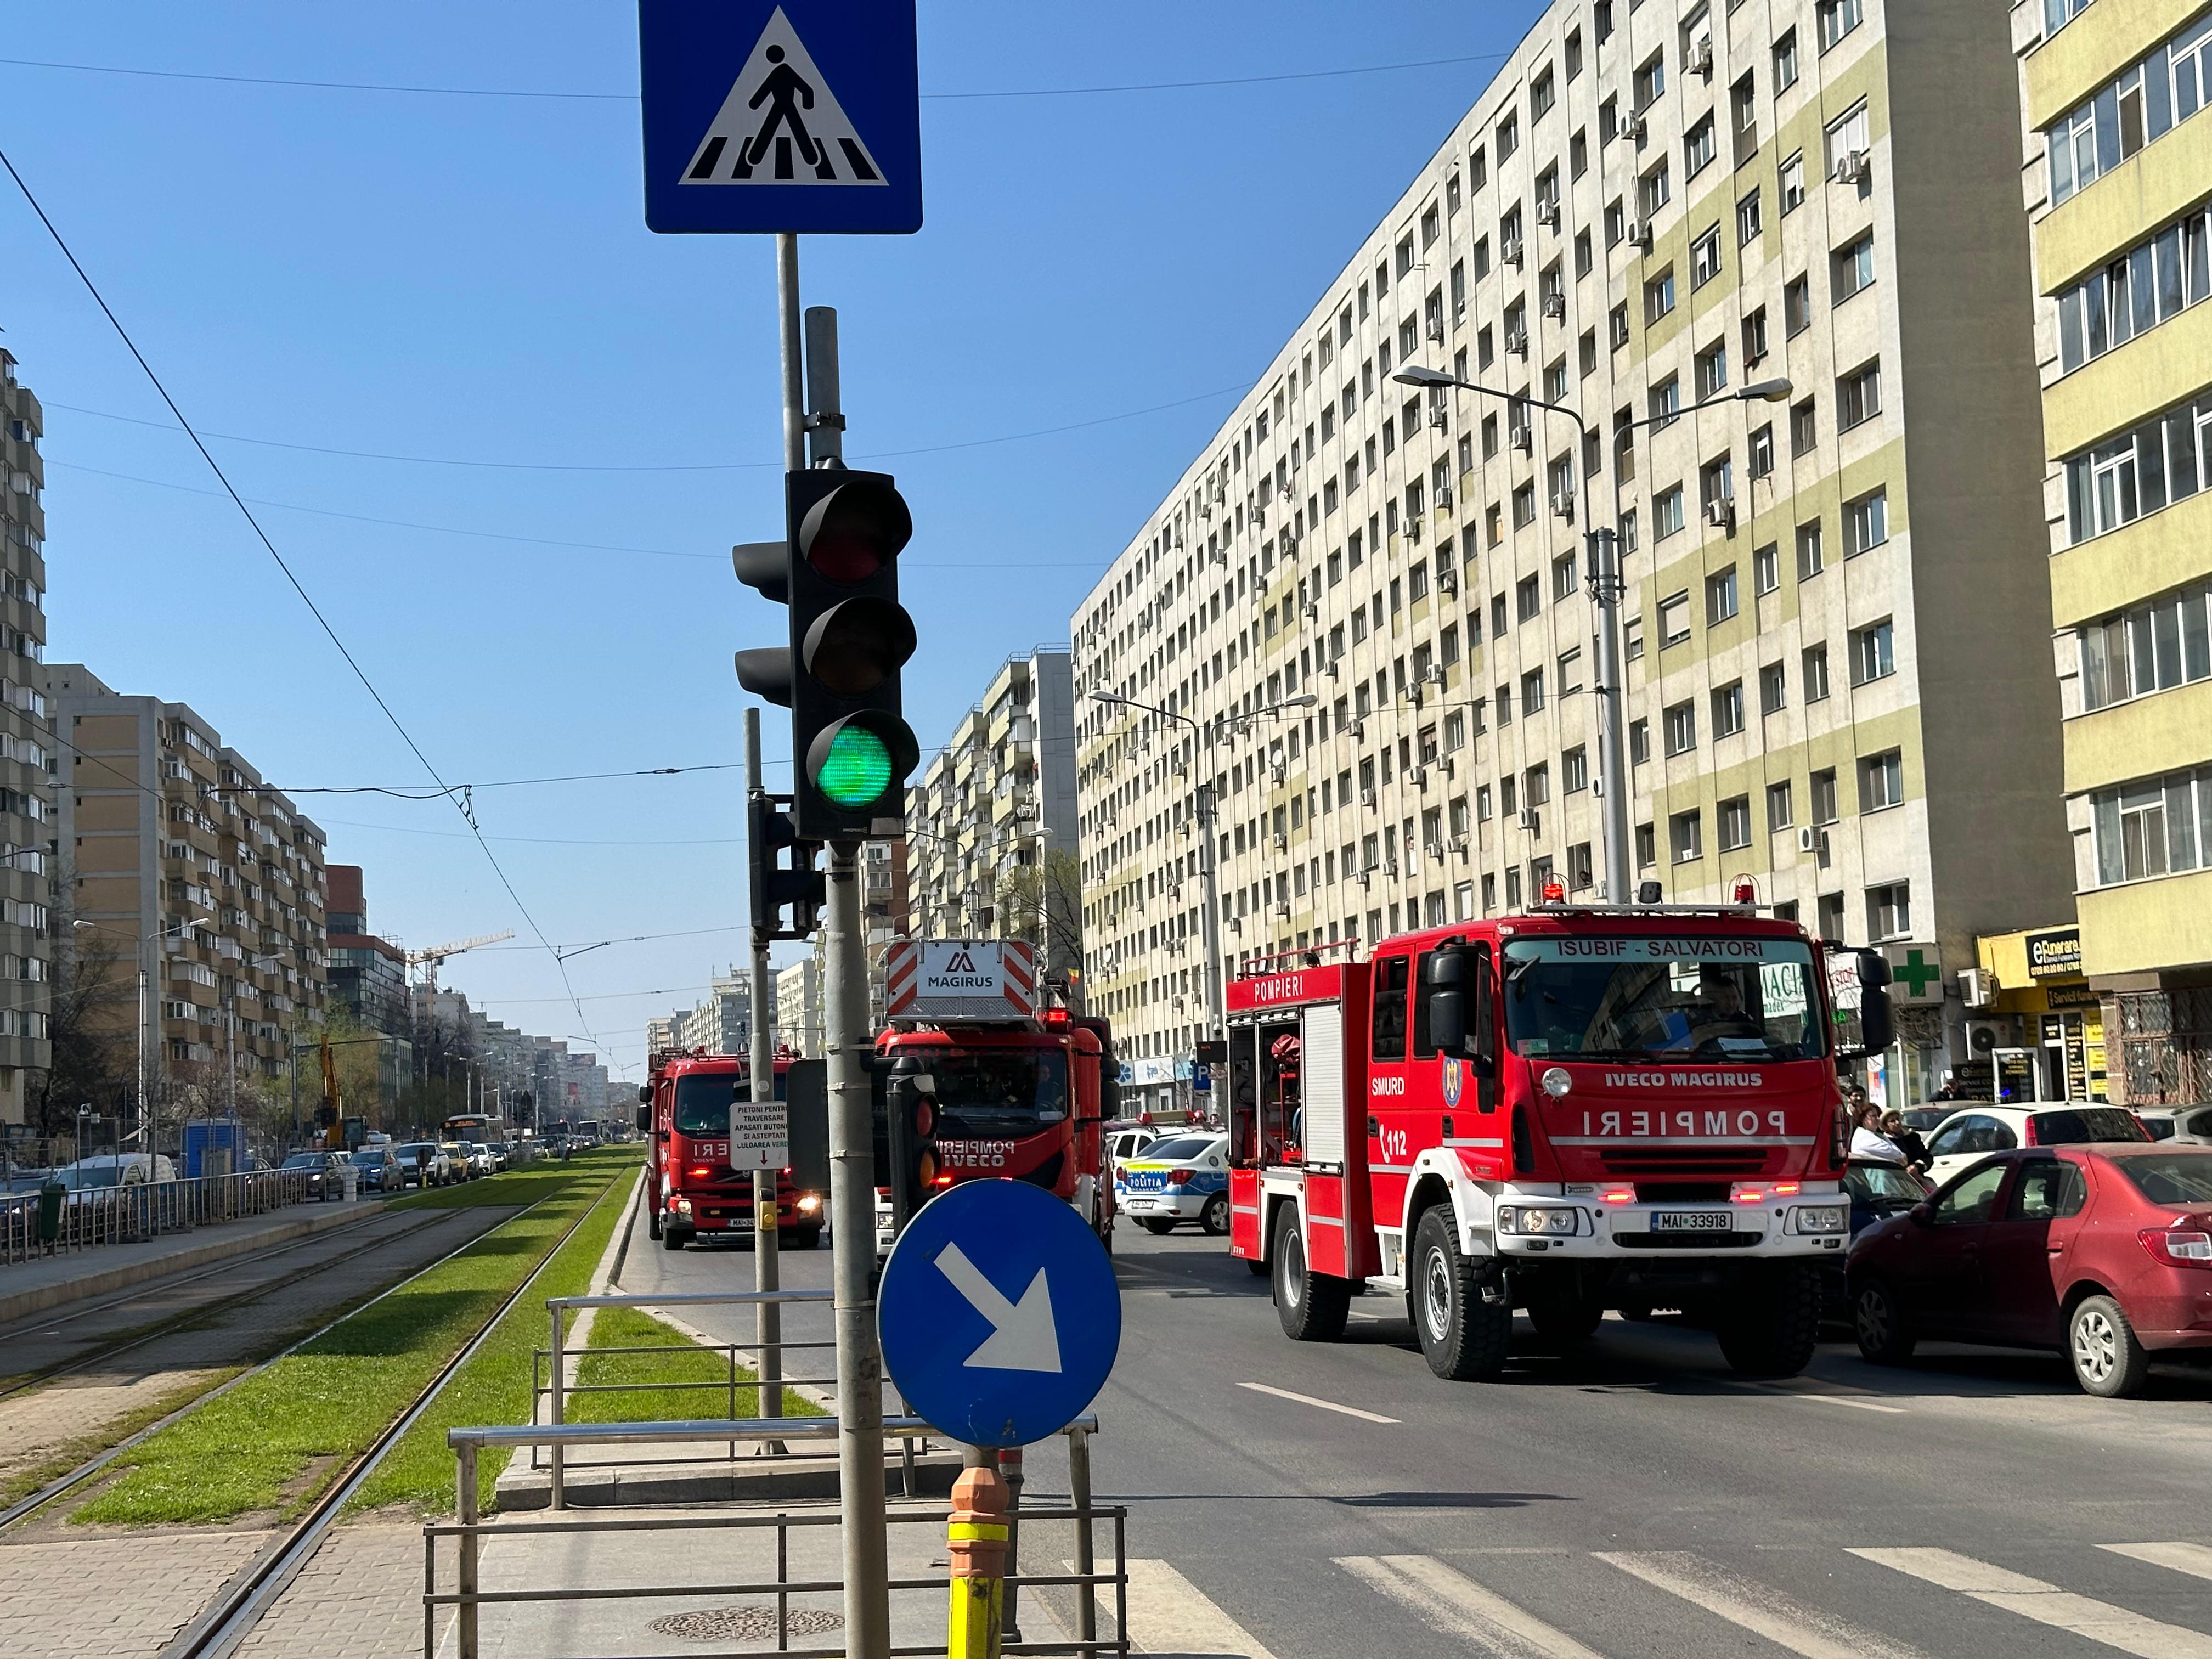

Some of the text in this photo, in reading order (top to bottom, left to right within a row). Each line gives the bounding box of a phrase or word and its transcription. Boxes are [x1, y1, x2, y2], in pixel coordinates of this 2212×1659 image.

[1558, 941, 1627, 956] ISUBIF
[1648, 941, 1763, 956] SALVATORI
[928, 976, 993, 988] MAGIRUS
[1255, 974, 1304, 1003] POMPIERI
[1198, 1065, 1208, 1081] P
[1605, 1073, 1763, 1087] IVECO MAGIRUS
[1372, 1077, 1404, 1096] SMURD
[743, 1114, 785, 1122] TRAVERSARE
[1387, 1130, 1407, 1156] 112
[944, 1154, 1005, 1167] IVECO
[1662, 1214, 1727, 1228] MAI 33918
